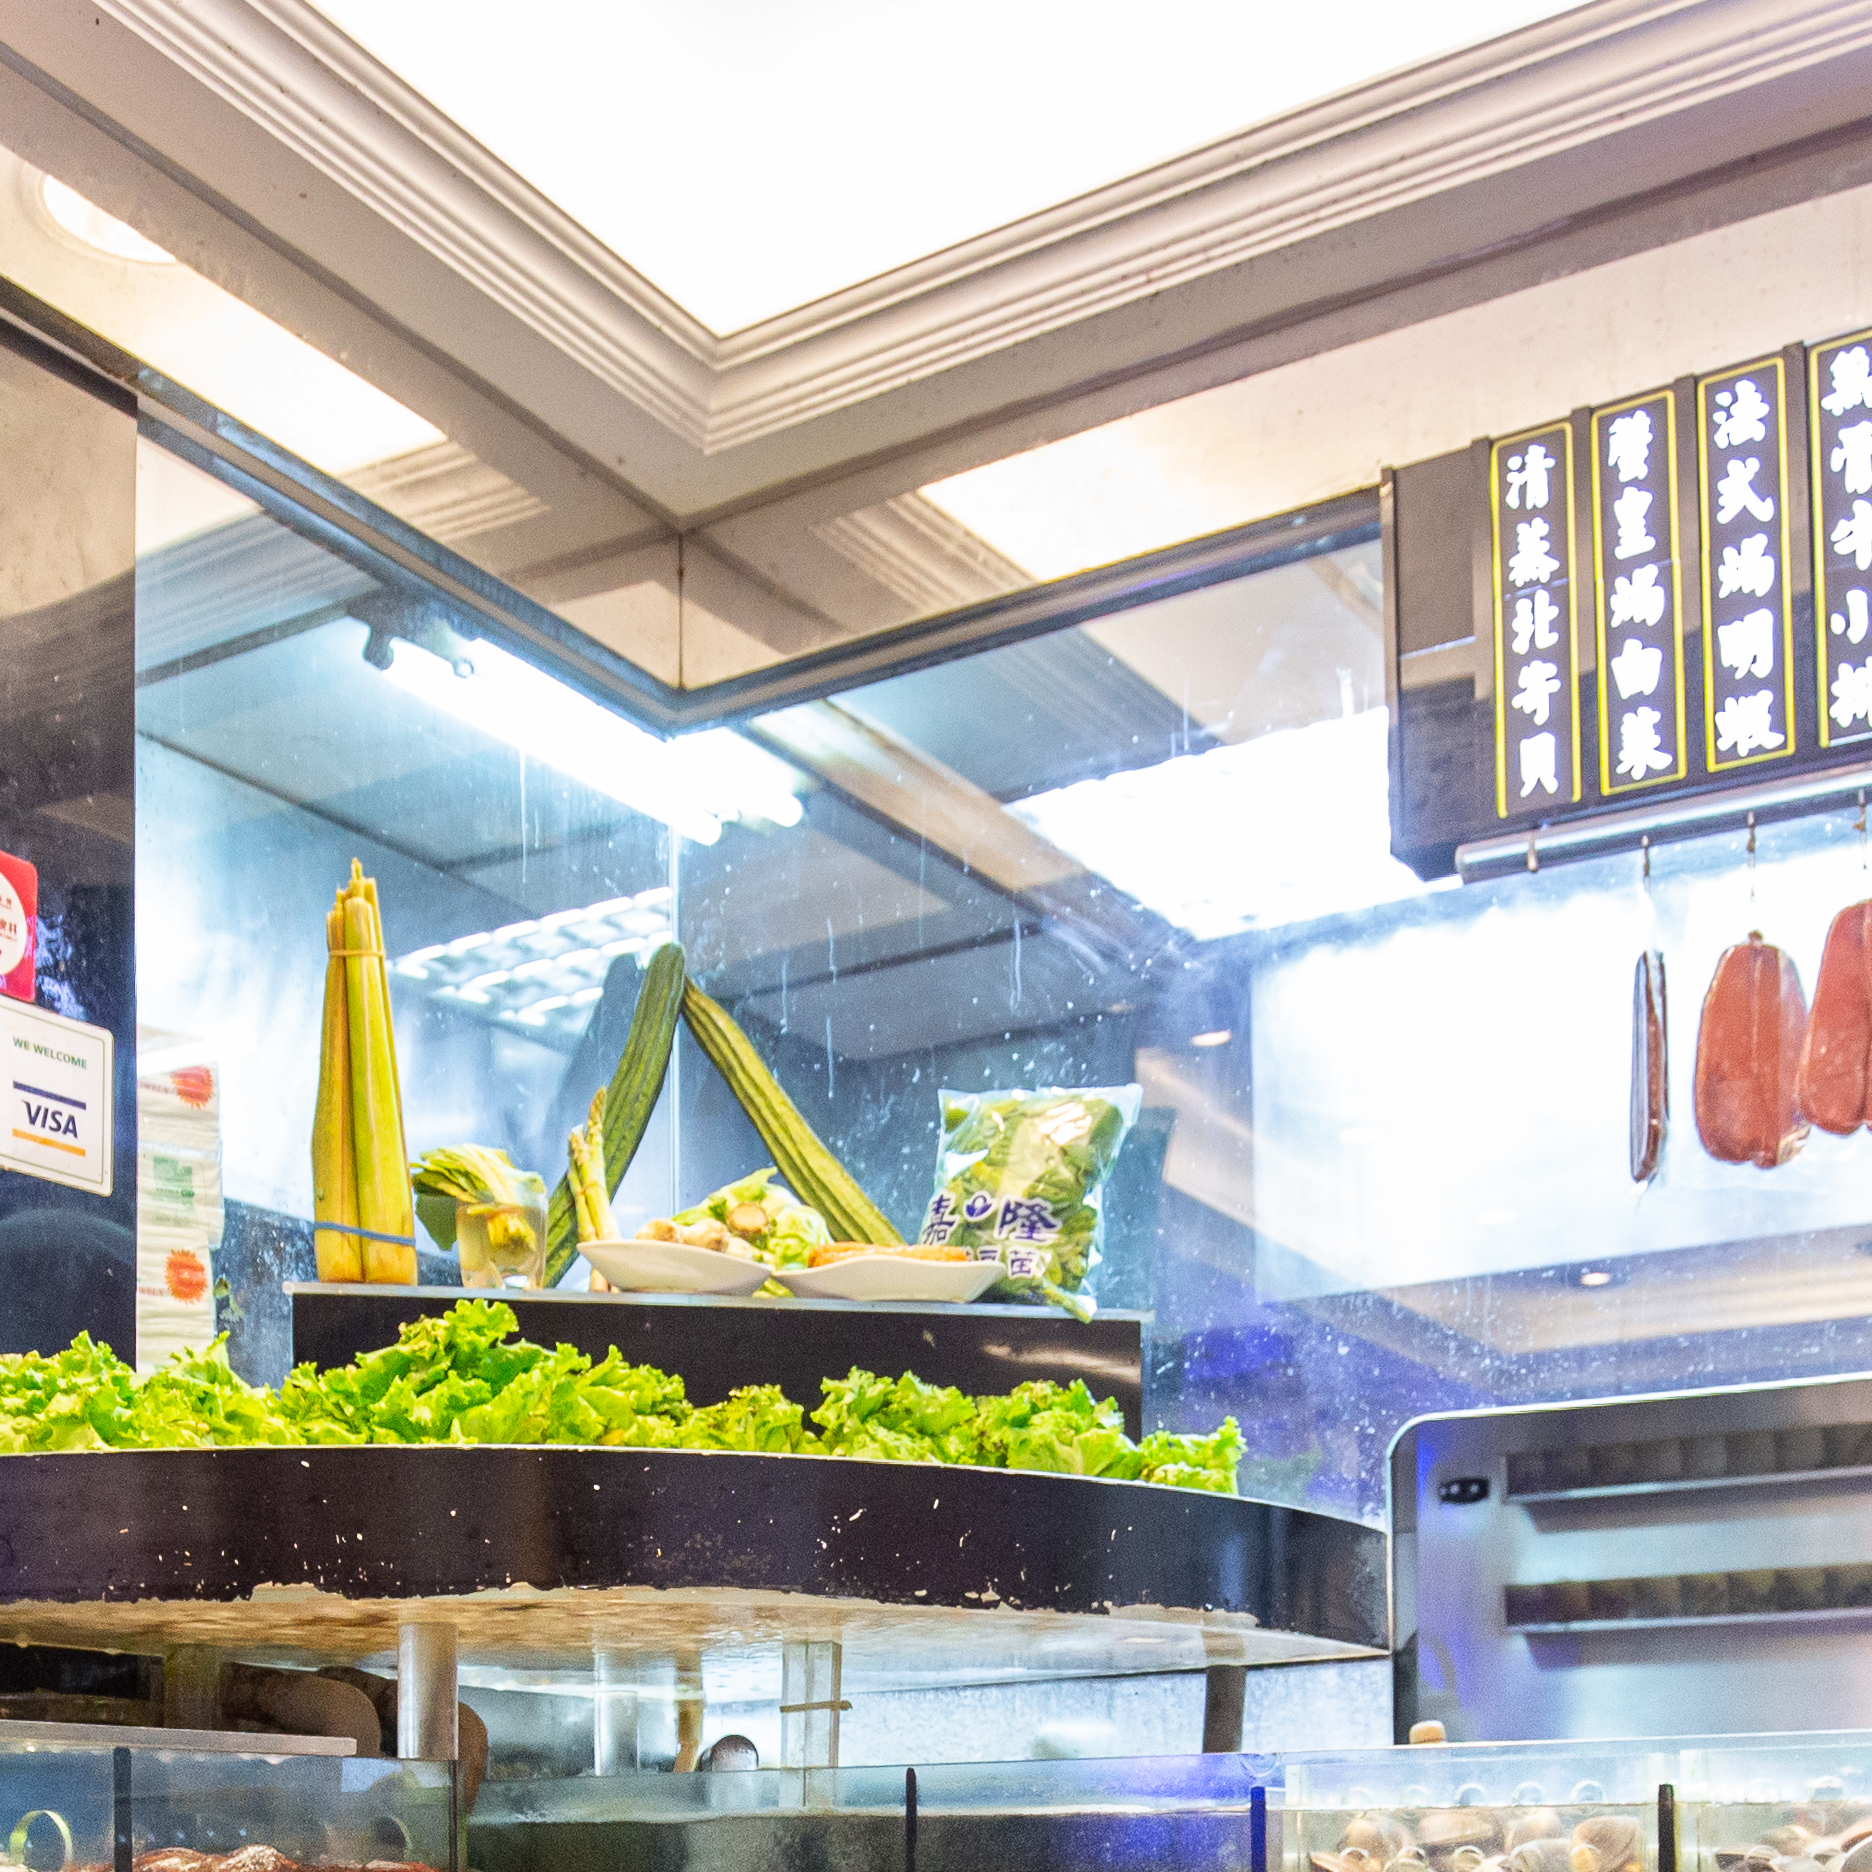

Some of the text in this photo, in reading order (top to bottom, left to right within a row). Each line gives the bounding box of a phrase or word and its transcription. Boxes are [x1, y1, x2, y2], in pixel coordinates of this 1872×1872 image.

[1506, 444, 1561, 797] 清蒸北寄貝
[1714, 379, 1785, 756] 法式焗明蝦
[12, 1036, 88, 1069] WE WELCOME
[21, 1099, 79, 1139] VISA
